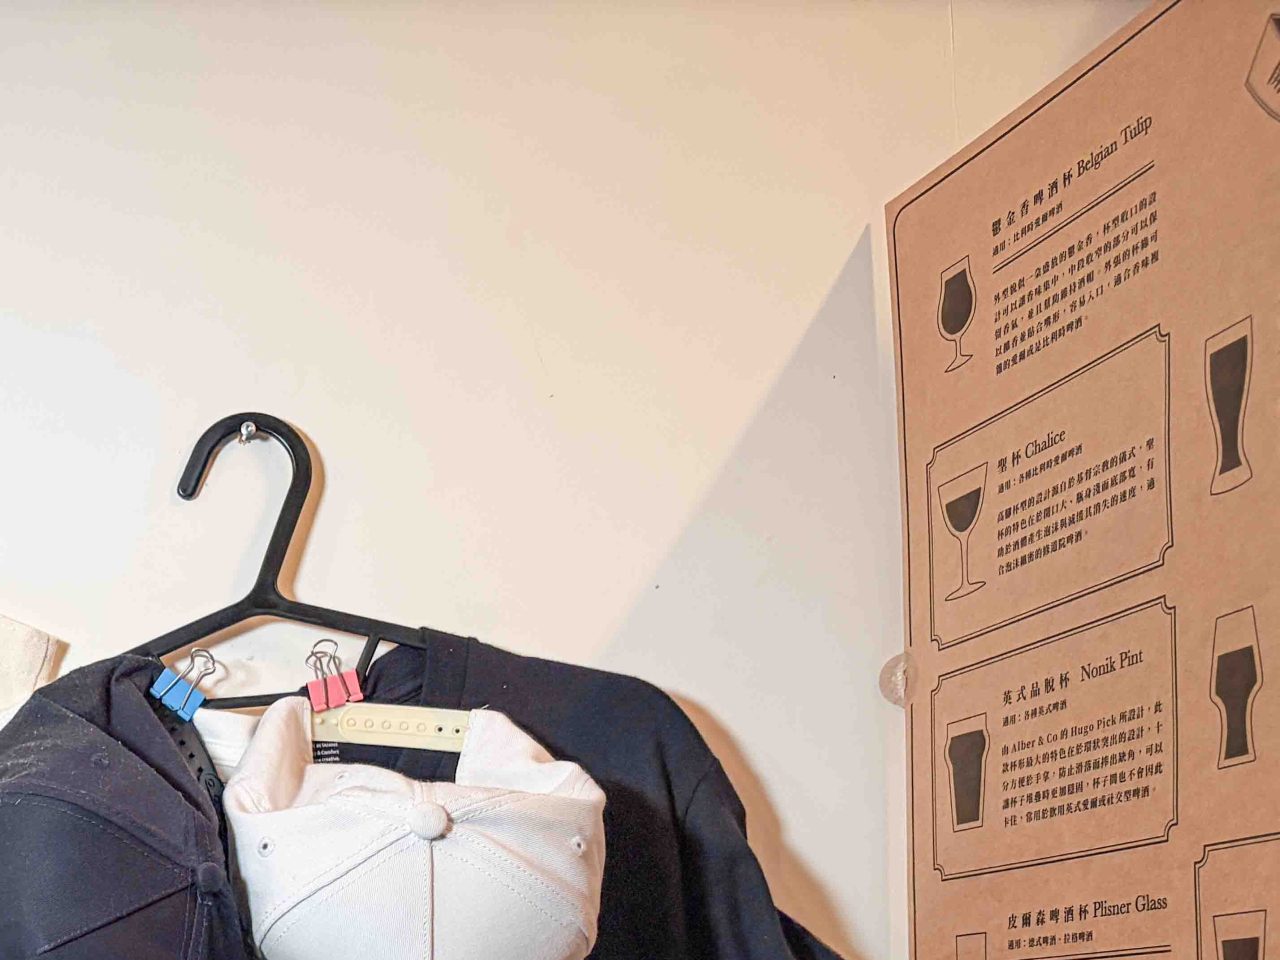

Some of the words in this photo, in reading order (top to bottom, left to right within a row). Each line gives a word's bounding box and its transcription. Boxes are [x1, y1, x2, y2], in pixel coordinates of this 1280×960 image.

[1077, 140, 1118, 178] Belgian
[1120, 116, 1152, 146] Tulip
[997, 448, 1022, 474] 聖杯
[1025, 430, 1066, 459] Chalice
[1002, 671, 1070, 707] 英式品脫杯
[1080, 656, 1116, 682] Nonik
[1119, 648, 1143, 670] Pint
[1001, 744, 1009, 757] 由
[1011, 739, 1036, 753] Alber
[1038, 736, 1044, 747] &
[1046, 732, 1058, 744] Co
[1060, 727, 1068, 741] 的
[1071, 723, 1094, 737] Hugo
[1097, 714, 1117, 731] Pick
[1008, 903, 1089, 930] 皮爾森啤酒杯
[1093, 900, 1132, 918] Plisner
[1135, 894, 1168, 913] Glass
